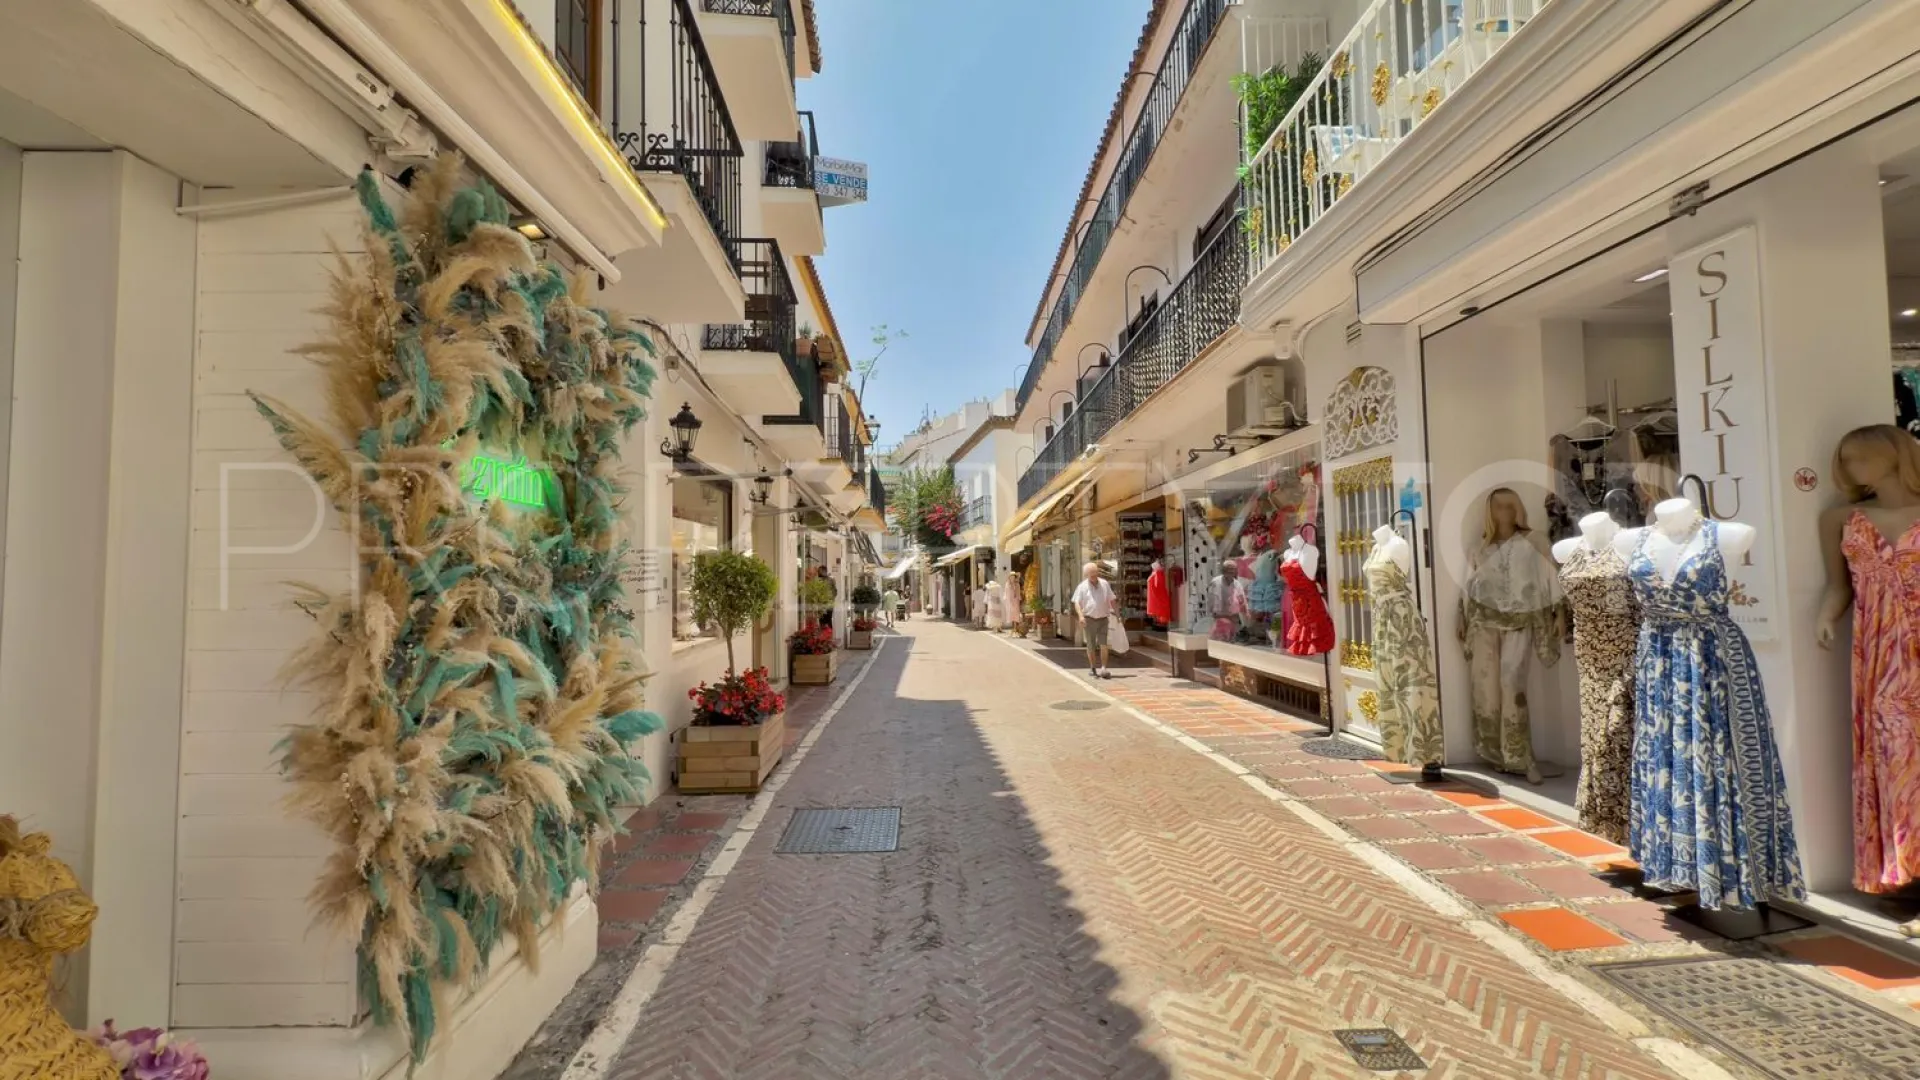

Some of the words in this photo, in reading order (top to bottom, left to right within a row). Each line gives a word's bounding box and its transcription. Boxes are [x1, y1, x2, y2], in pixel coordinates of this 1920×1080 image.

[815, 172, 829, 183] SE
[832, 173, 867, 189] VENDE
[1697, 251, 1754, 566] SILKIU
